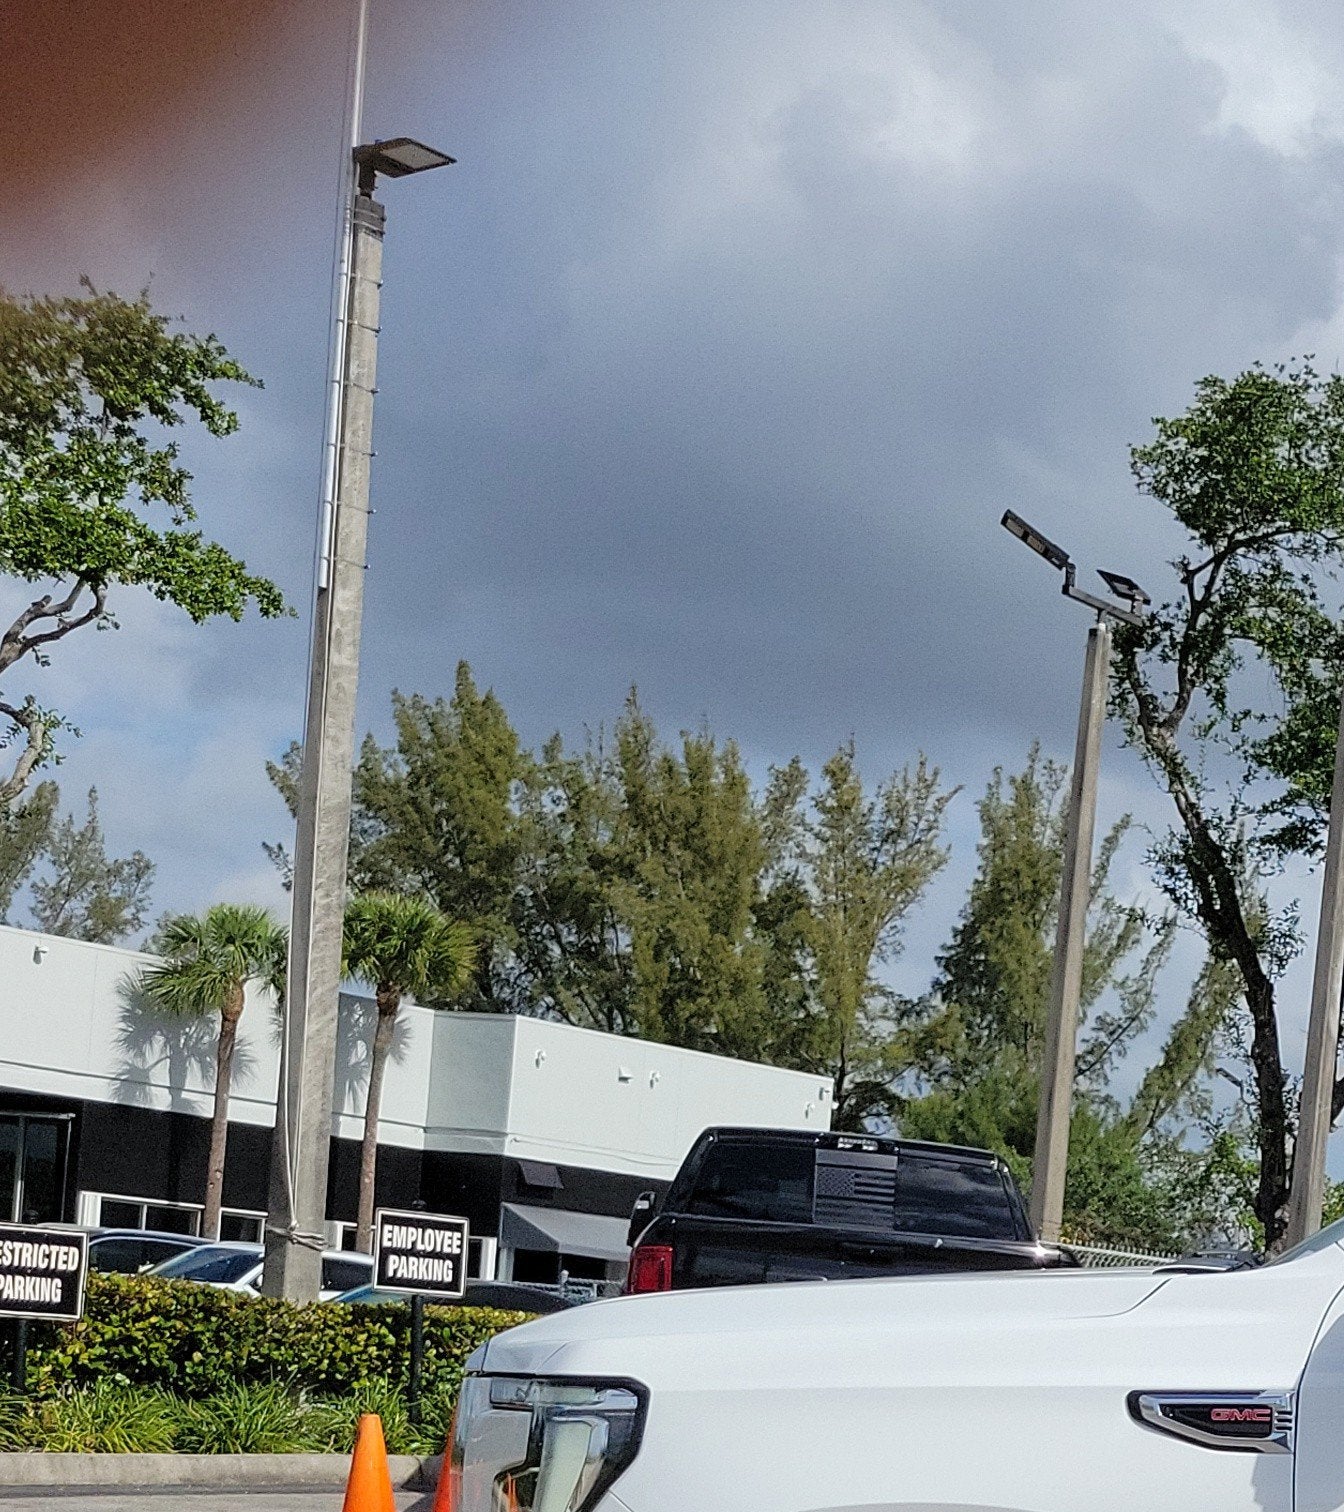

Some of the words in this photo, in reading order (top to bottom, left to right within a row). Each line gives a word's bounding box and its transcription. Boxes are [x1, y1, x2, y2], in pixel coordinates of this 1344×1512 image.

[382, 1224, 462, 1254] EMPLOYEE
[388, 1254, 454, 1283] PARKING
[1211, 1408, 1271, 1421] GMC
